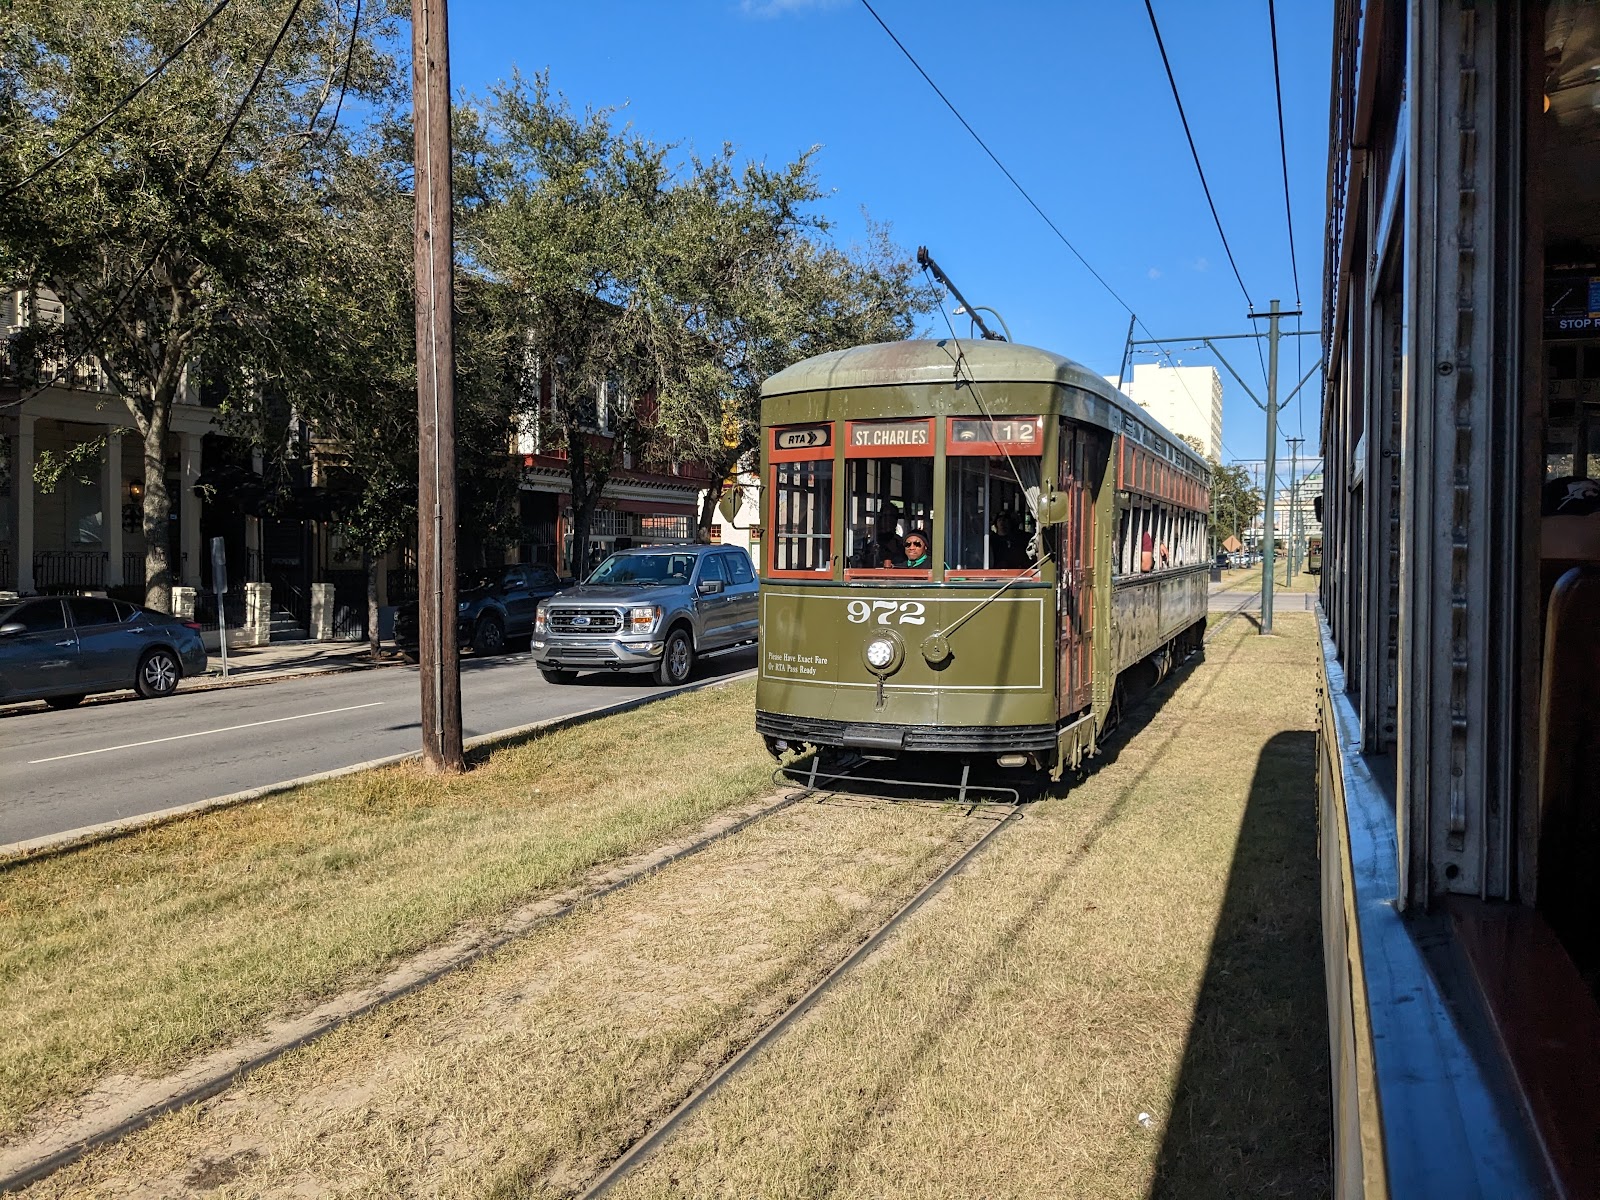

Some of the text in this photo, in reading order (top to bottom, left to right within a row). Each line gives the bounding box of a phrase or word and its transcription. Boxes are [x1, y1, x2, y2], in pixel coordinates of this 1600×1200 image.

[1560, 319, 1591, 329] STOP
[788, 434, 806, 445] RTA
[855, 429, 927, 446] ST. CHARLES
[1003, 425, 1033, 440] 12
[847, 600, 926, 625] 972
[768, 651, 828, 665] Please Have Exact Fare
[767, 662, 817, 676] Or RTA Pass Ready
